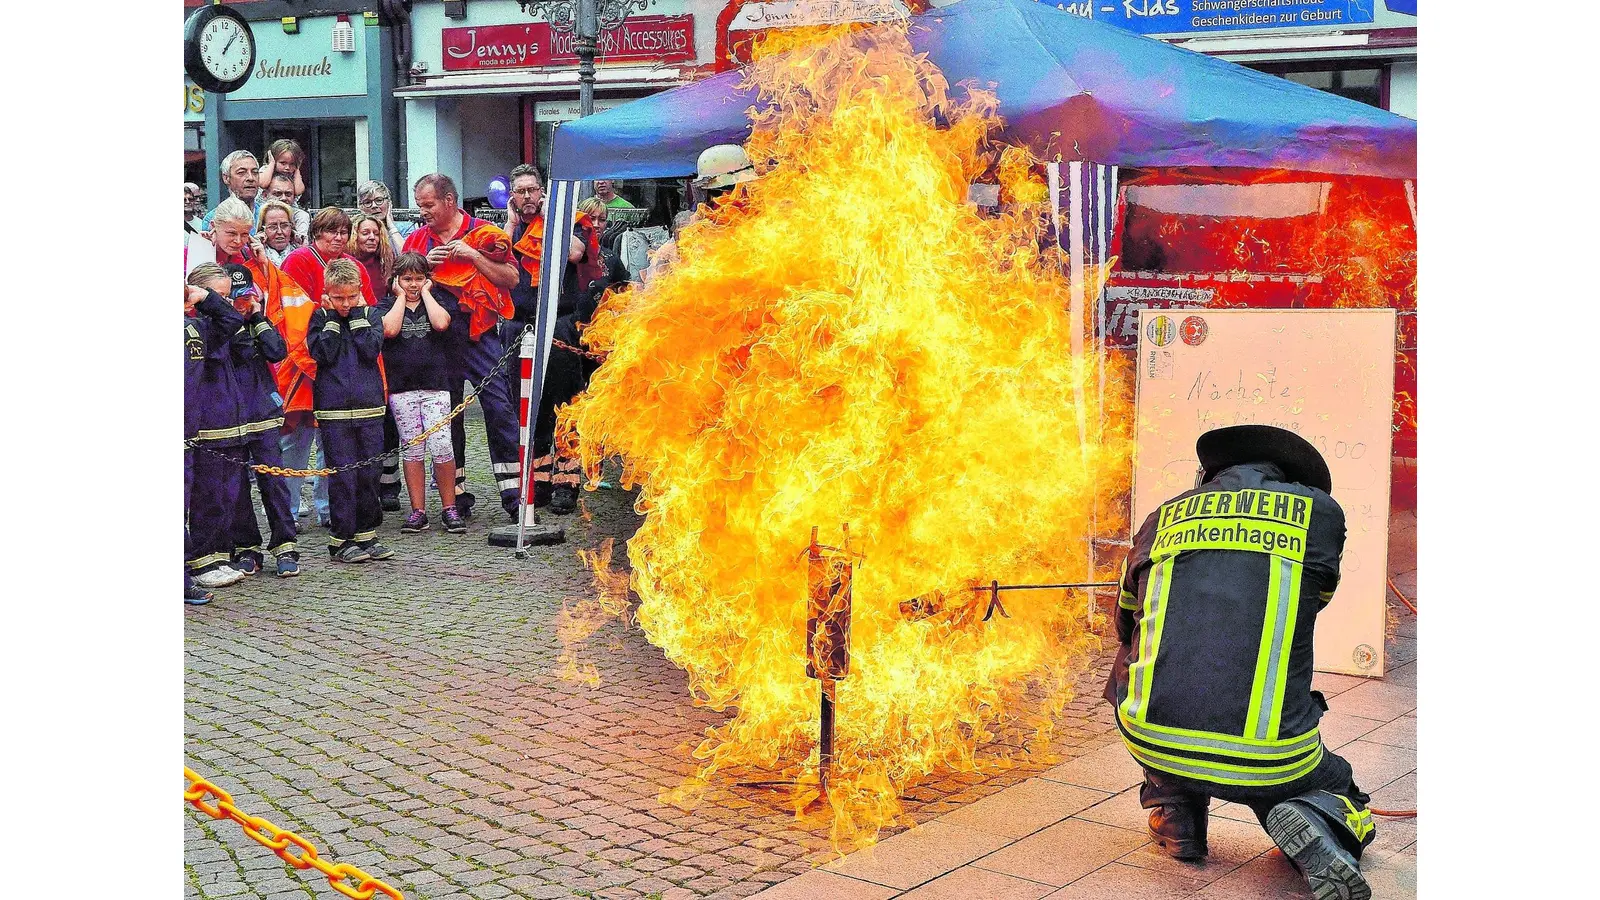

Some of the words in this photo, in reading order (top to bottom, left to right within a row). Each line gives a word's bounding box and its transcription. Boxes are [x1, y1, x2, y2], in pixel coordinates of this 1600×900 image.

[1123, 0, 1180, 18] Kids
[1192, 13, 1277, 27] Geschenkideen
[1280, 12, 1298, 22] zur
[1301, 9, 1342, 20] Geburt
[448, 27, 539, 62] Jenny's
[623, 27, 686, 51] Accessoires
[255, 55, 332, 80] Schmuck
[506, 57, 517, 65] più
[184, 84, 206, 113] S
[567, 107, 581, 115] Mod
[1187, 367, 1291, 400] Nächste
[1161, 491, 1307, 528] FEUERWEHR
[1153, 523, 1301, 553] Krankenhagen
